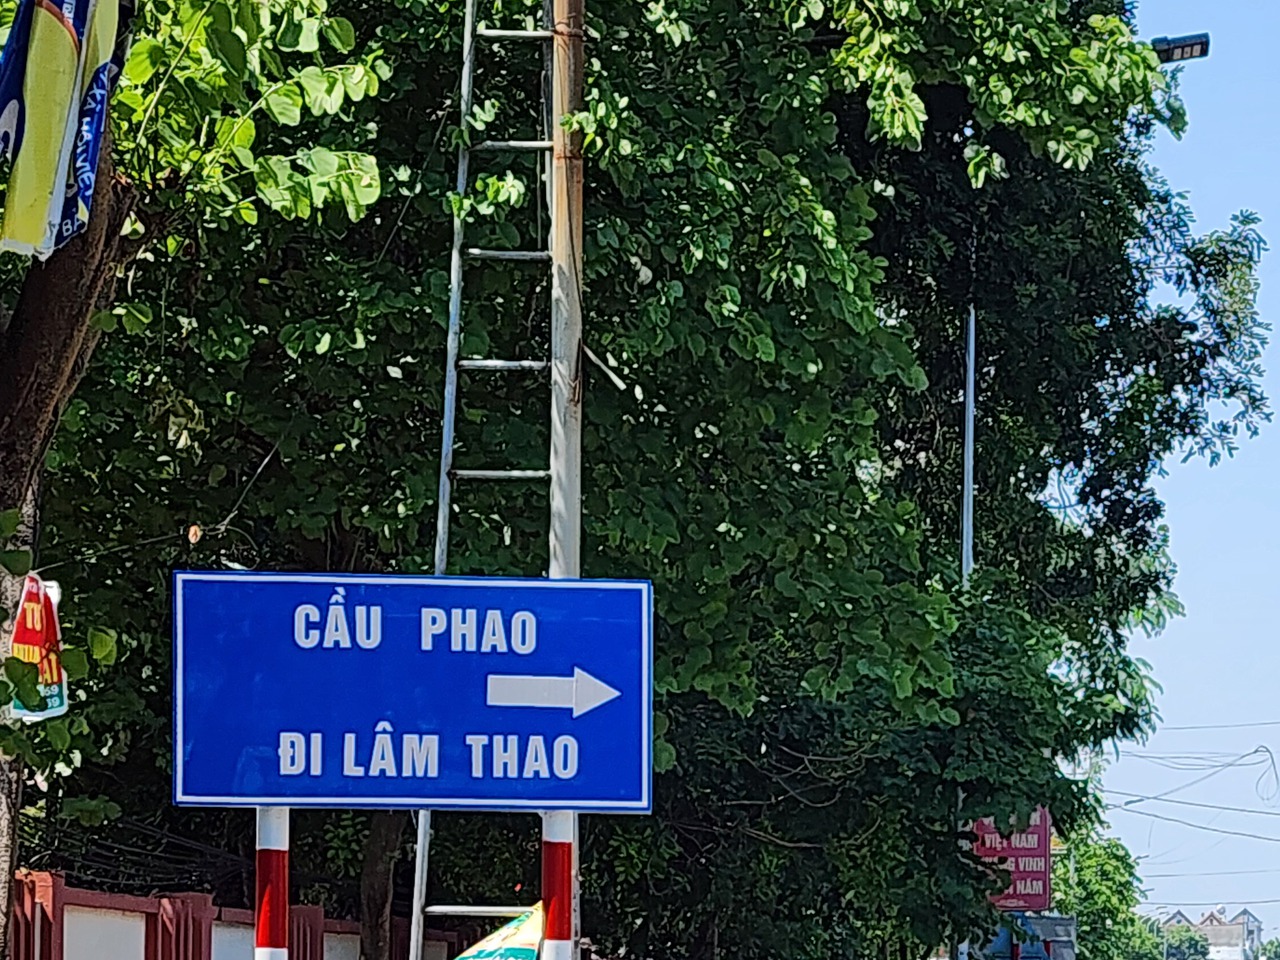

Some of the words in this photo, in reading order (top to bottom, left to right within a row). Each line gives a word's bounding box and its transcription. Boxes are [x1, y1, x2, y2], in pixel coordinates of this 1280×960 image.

[293, 586, 383, 650] CẦU
[420, 606, 538, 656] PHAO
[278, 731, 323, 777] ĐI
[342, 720, 440, 778] LÂM
[465, 734, 579, 780] THAO
[1018, 856, 1045, 872] VINH
